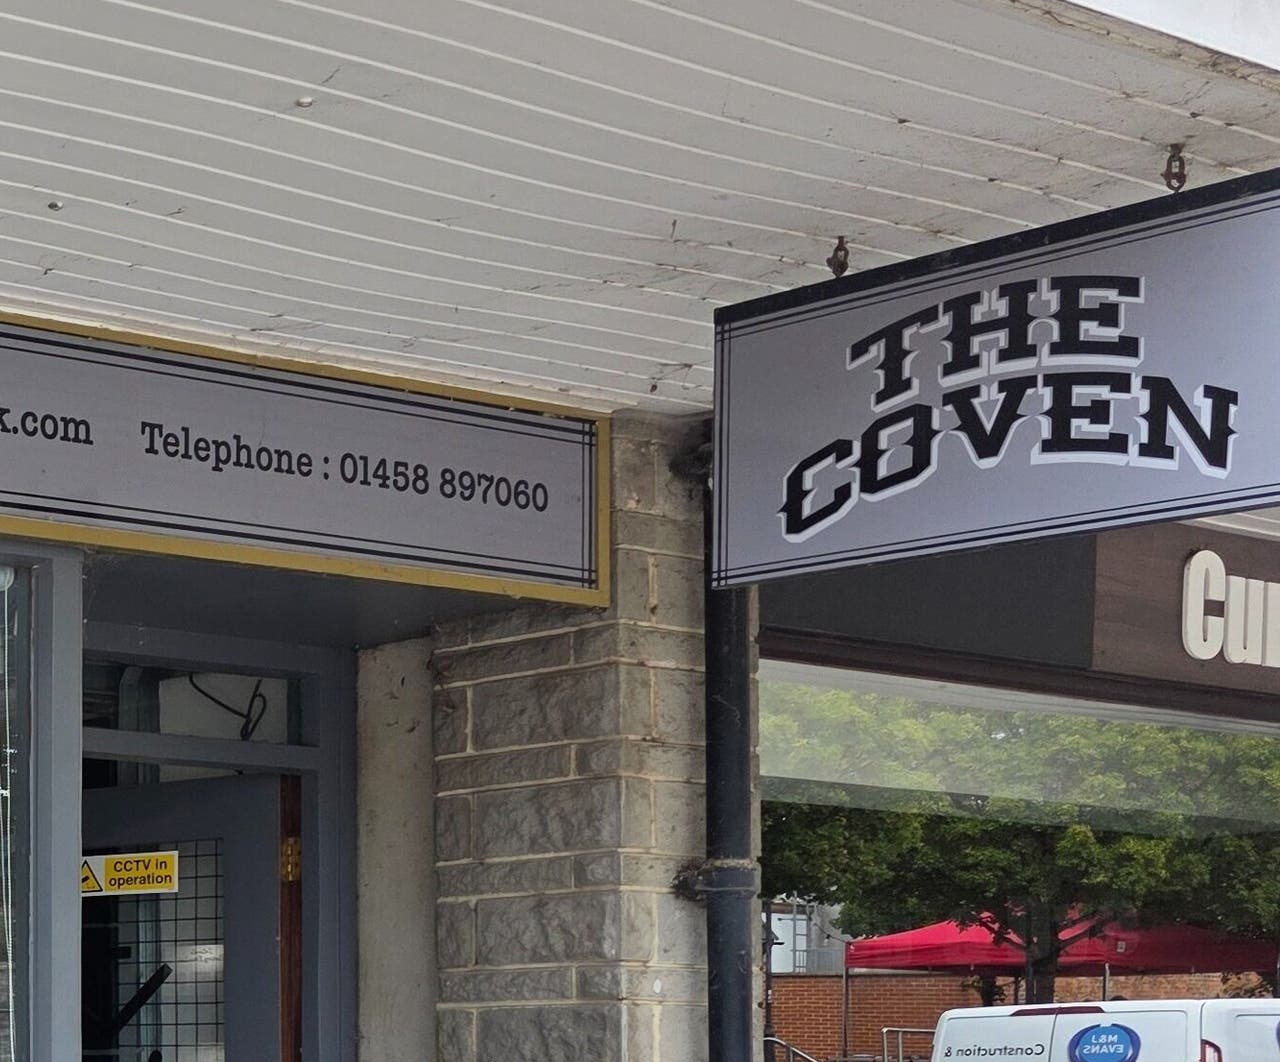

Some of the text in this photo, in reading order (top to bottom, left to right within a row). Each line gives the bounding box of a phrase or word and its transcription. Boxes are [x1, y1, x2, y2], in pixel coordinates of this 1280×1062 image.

[846, 275, 1144, 412] THE
[141, 420, 313, 478] Telephone
[340, 452, 430, 495] 01458
[439, 467, 549, 512] 897060
[776, 371, 1239, 543] COVEN
[109, 873, 172, 889] operation
[113, 858, 167, 872] CCTV in
